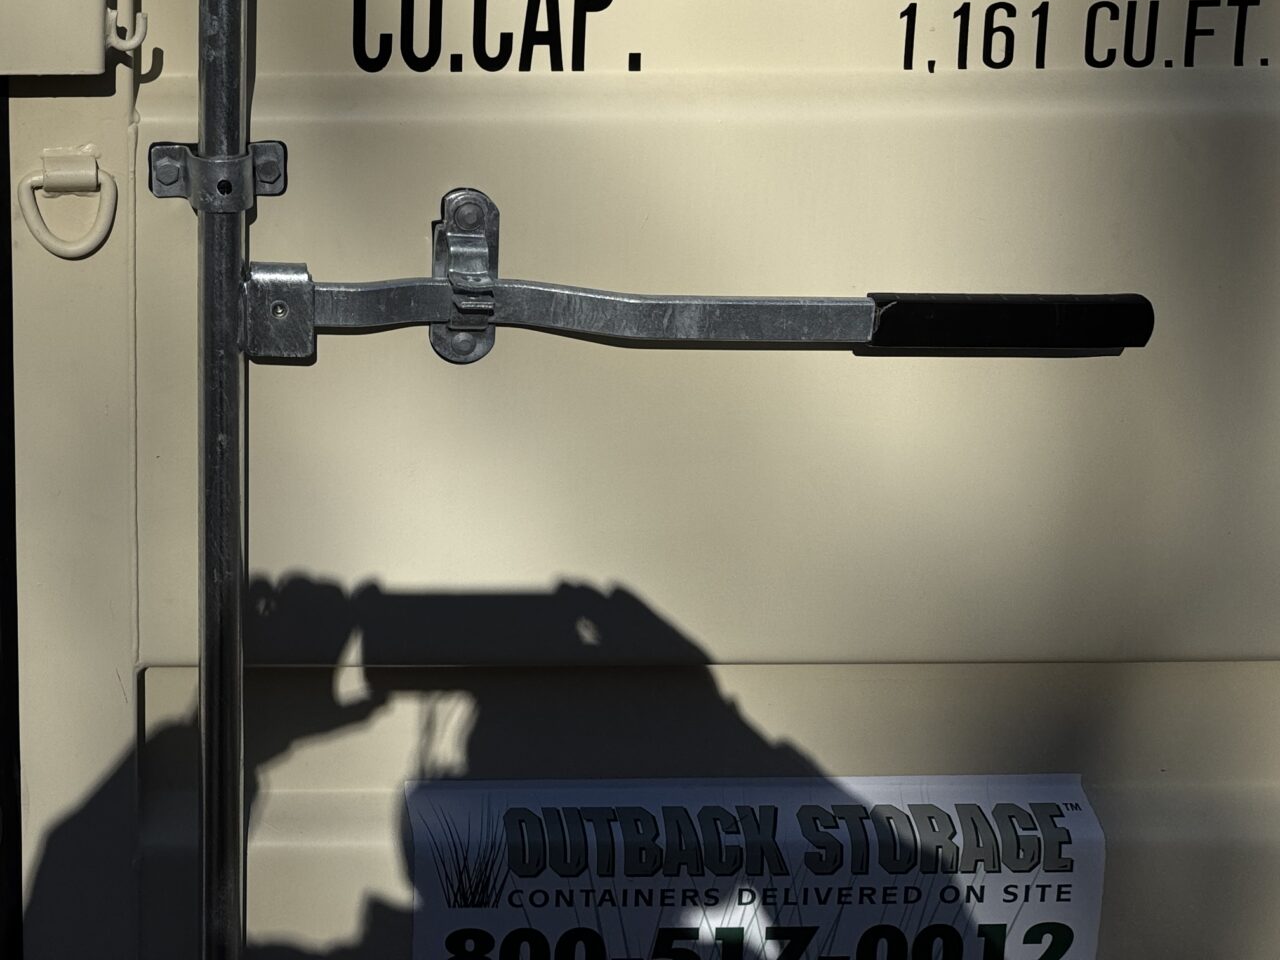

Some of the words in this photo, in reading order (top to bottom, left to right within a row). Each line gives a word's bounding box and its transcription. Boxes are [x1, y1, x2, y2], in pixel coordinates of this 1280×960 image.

[900, 1, 1049, 73] 1,161
[1085, 0, 1268, 68] CU.FT.
[503, 805, 790, 878] OUTBACK
[507, 888, 720, 908] CONTAINERS
[737, 886, 922, 907] DELIVERED
[939, 885, 985, 904] ON
[1002, 884, 1072, 903] SITE
